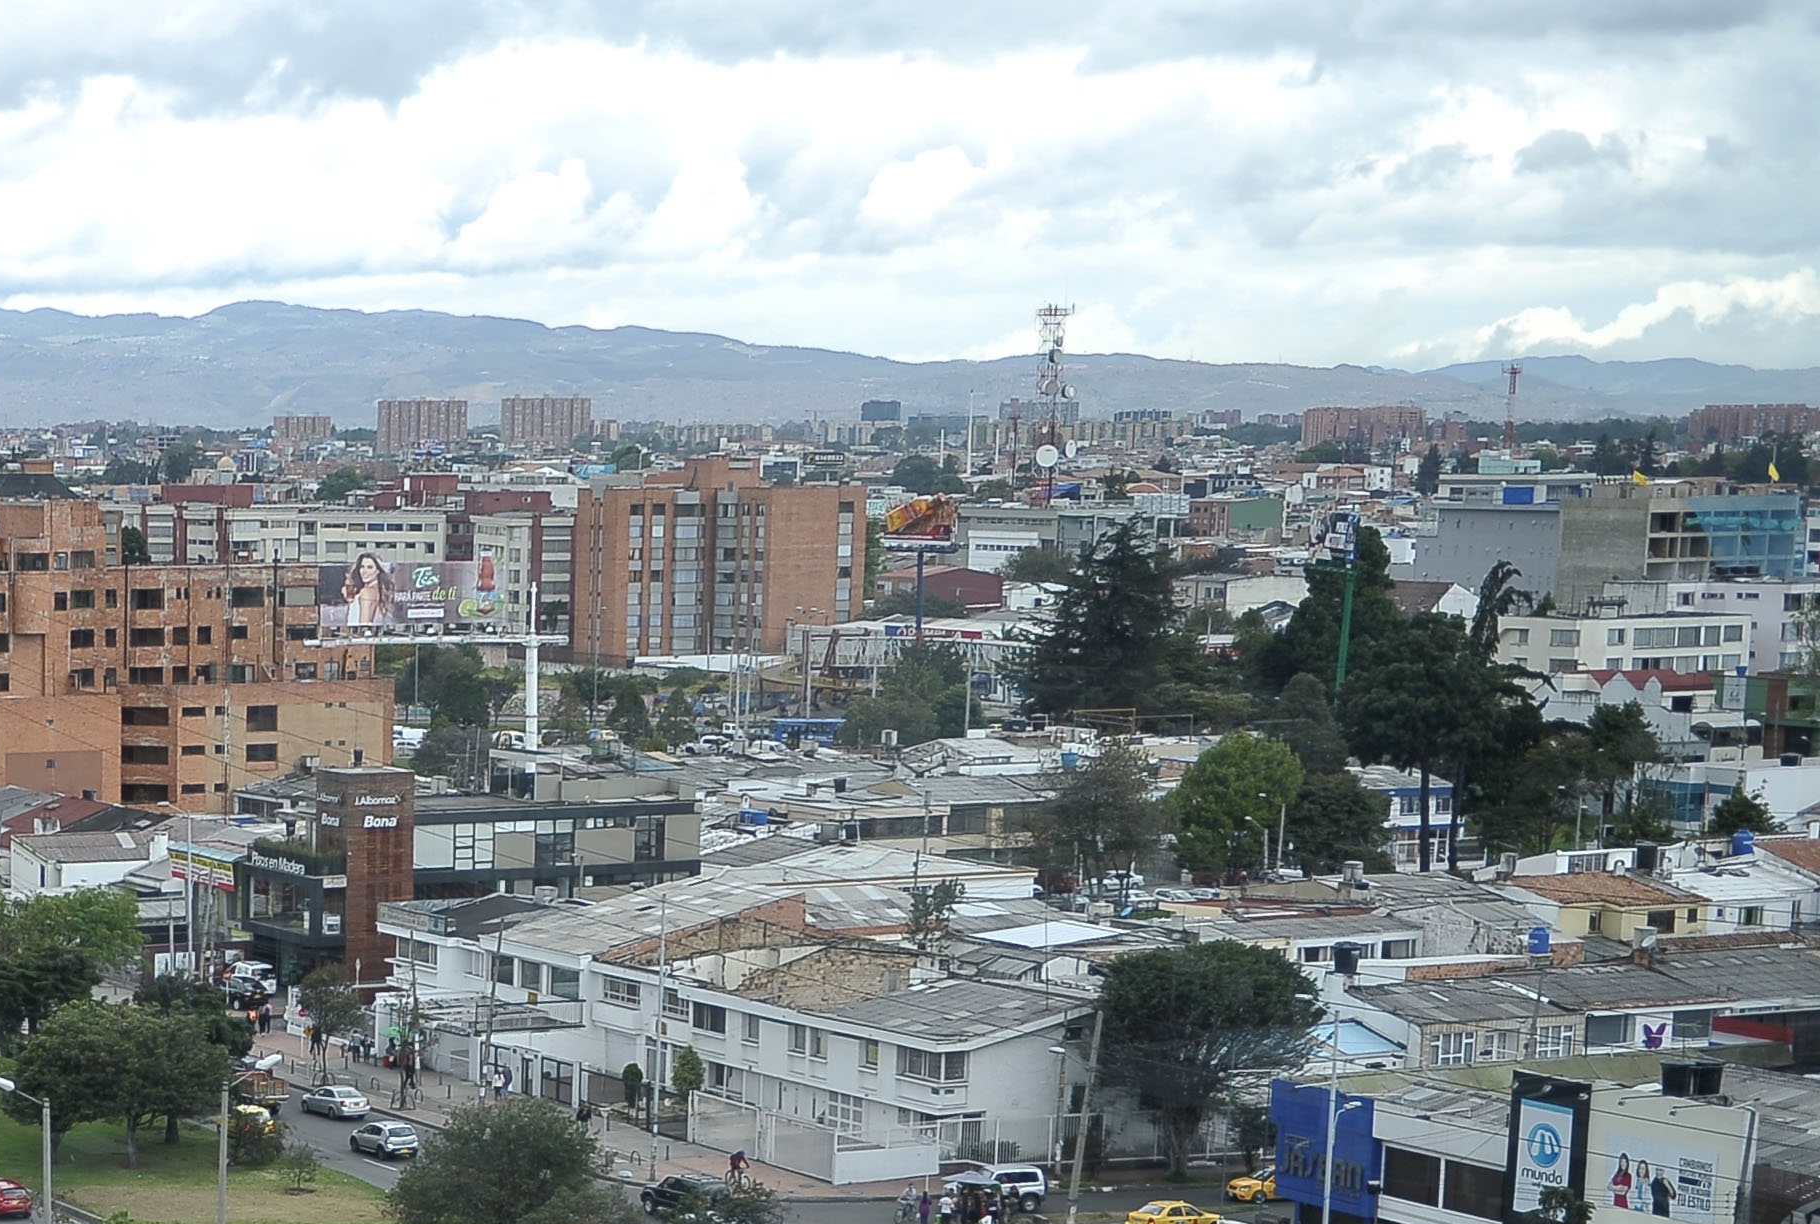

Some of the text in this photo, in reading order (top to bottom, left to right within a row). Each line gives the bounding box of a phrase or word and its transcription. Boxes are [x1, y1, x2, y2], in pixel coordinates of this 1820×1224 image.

[363, 815, 397, 828] Bona
[1521, 1167, 1563, 1185] mundo
[1687, 1195, 1711, 1211] ESTILO
